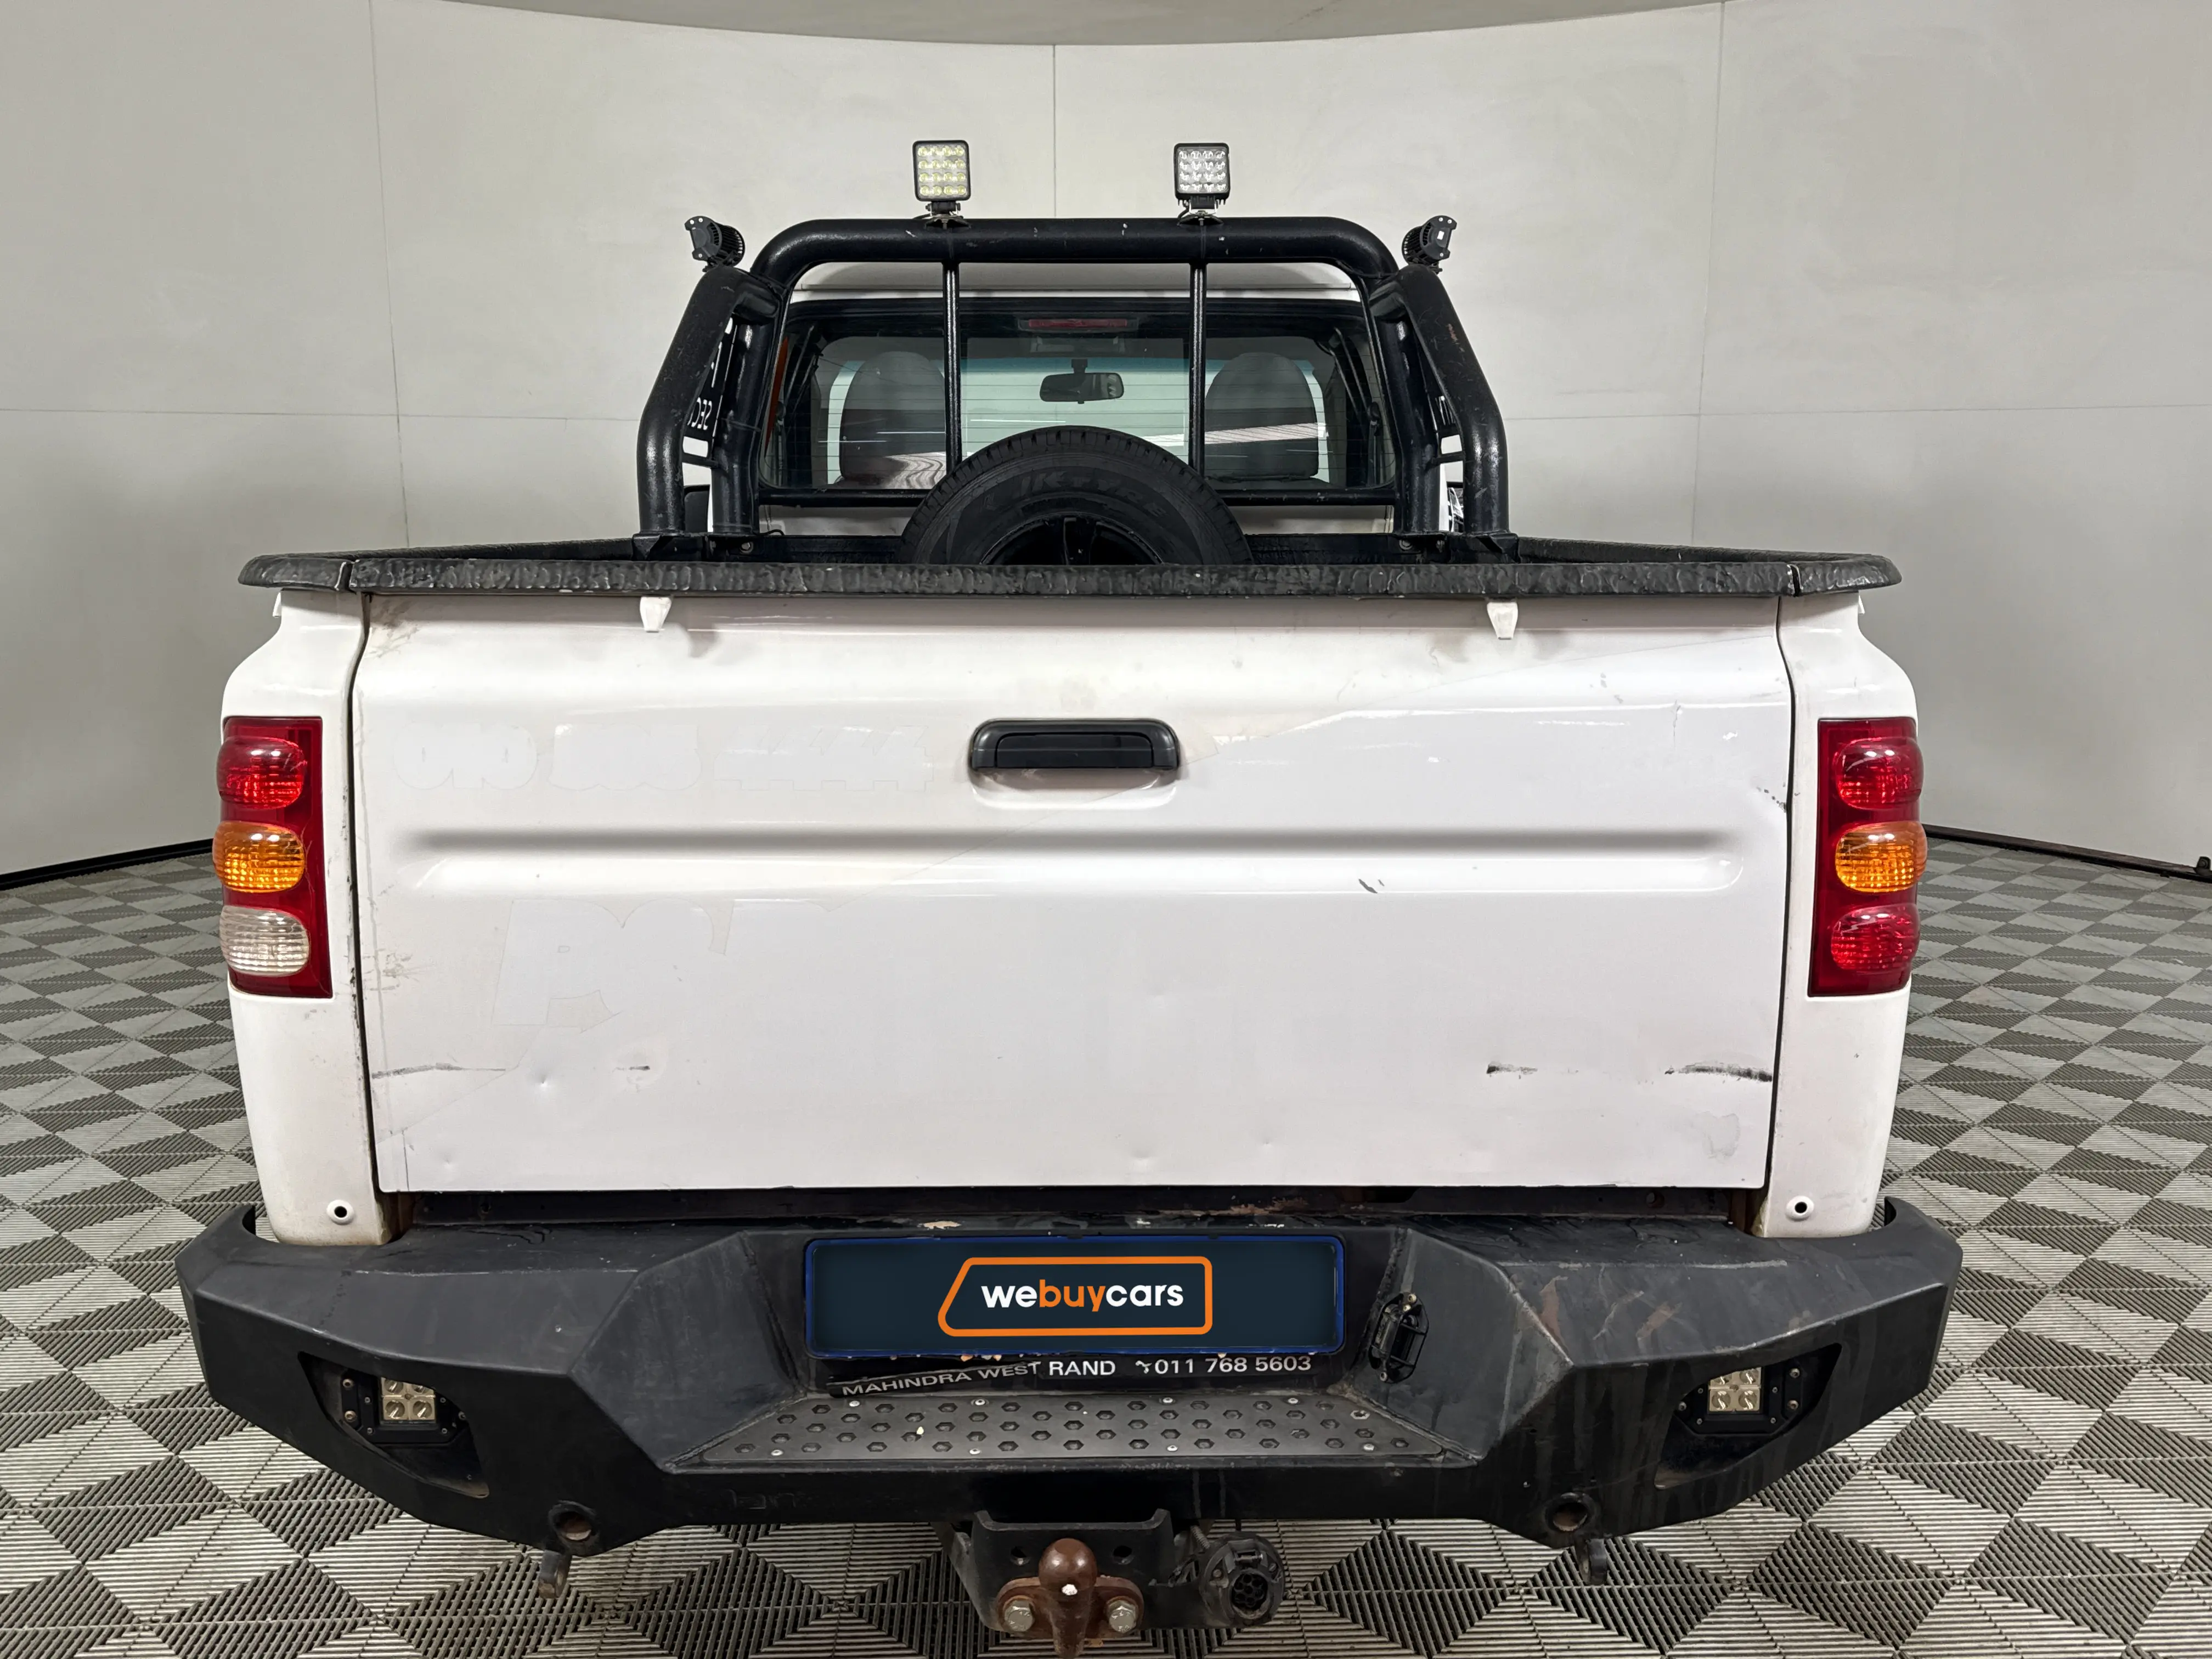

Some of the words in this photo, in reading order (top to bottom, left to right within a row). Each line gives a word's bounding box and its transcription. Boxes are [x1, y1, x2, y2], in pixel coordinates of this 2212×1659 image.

[842, 1372, 972, 1395] MAHINDRA
[978, 1362, 1041, 1379] WEST
[1049, 1361, 1116, 1376] RAND
[1154, 1359, 1194, 1374] 011
[1205, 1357, 1248, 1373] 768
[1255, 1356, 1311, 1372] 5603
